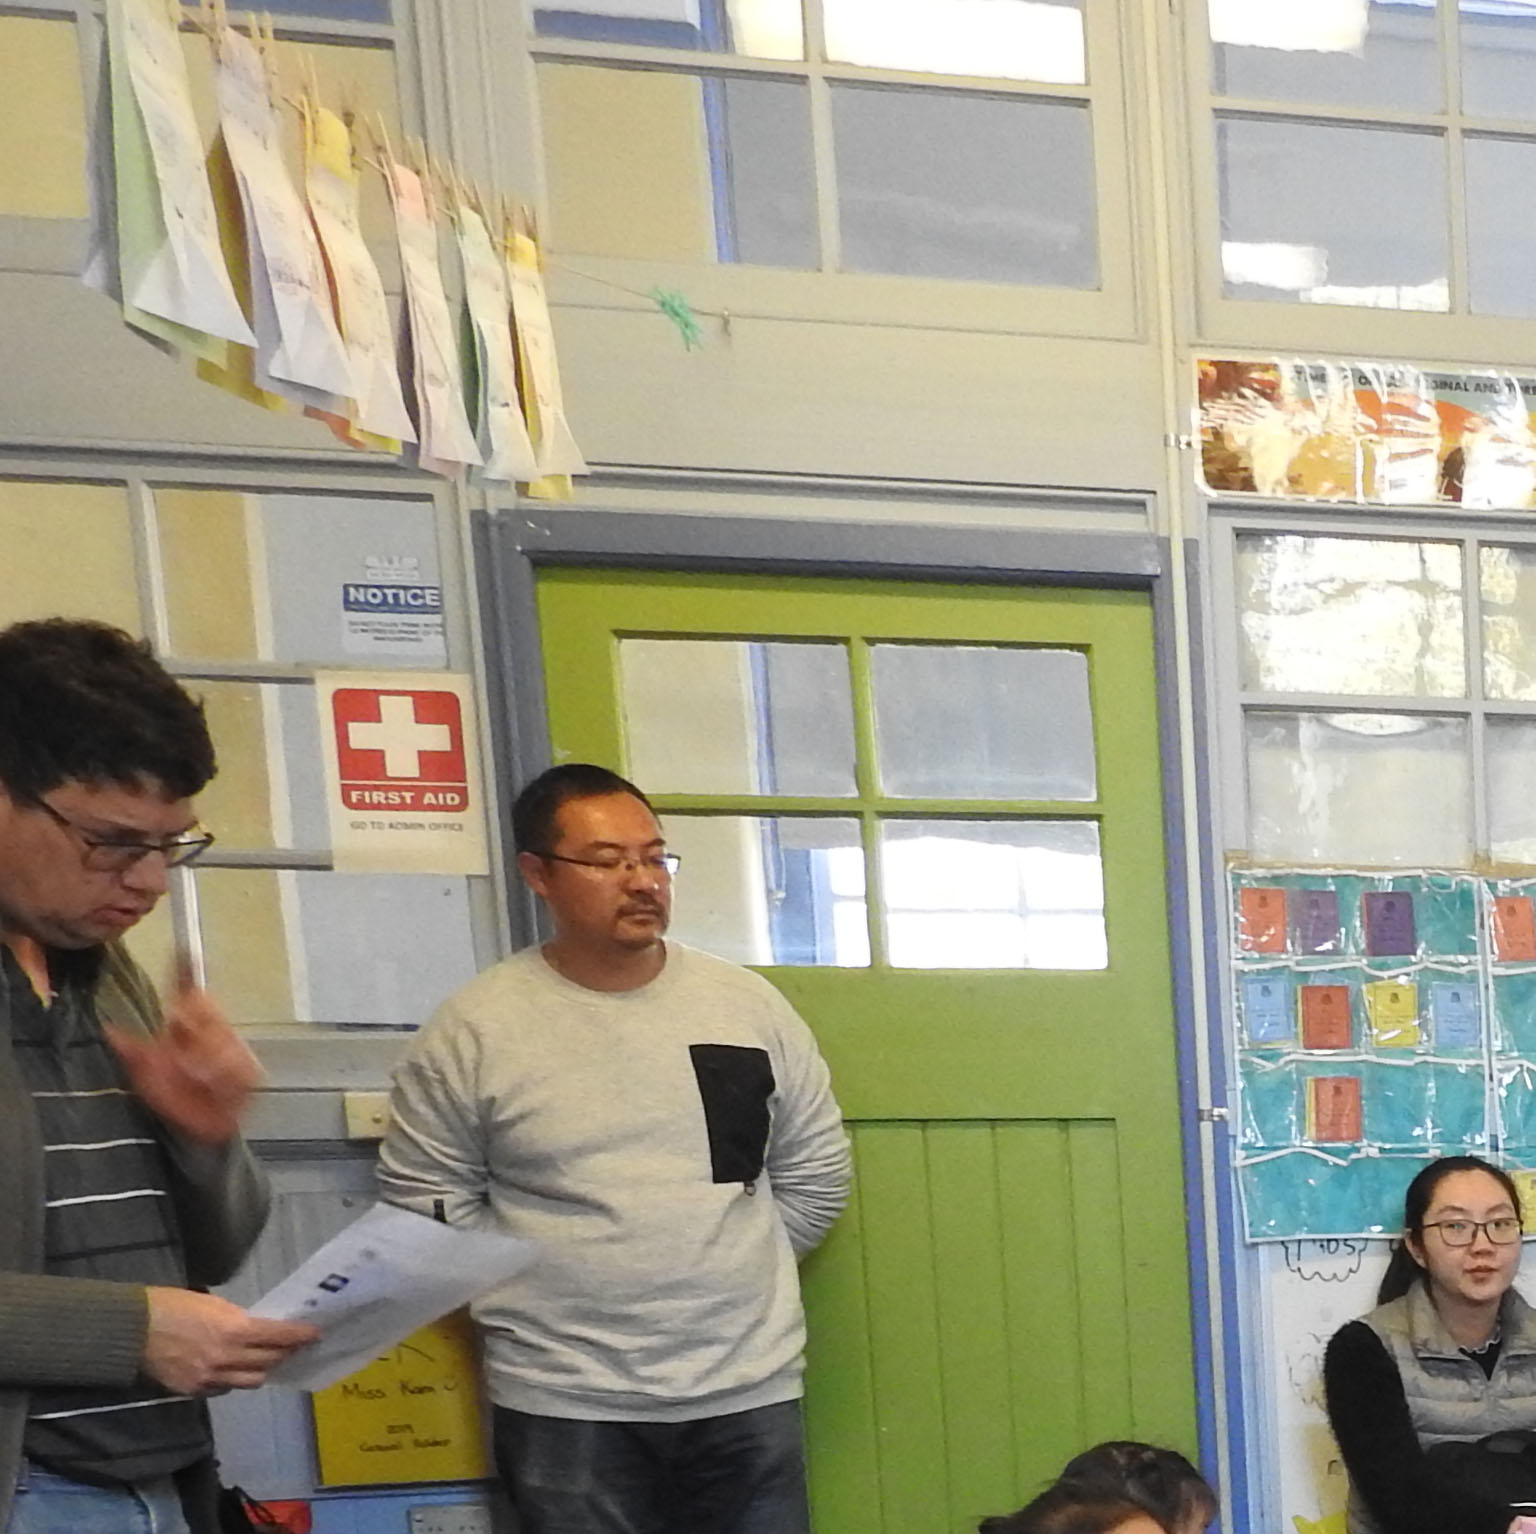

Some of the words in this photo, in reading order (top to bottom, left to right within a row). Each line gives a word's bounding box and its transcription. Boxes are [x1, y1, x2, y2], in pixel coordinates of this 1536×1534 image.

[348, 587, 441, 607] NOTICE
[350, 791, 416, 806] FIRST
[423, 791, 461, 806] AID
[341, 1382, 387, 1400] Miss
